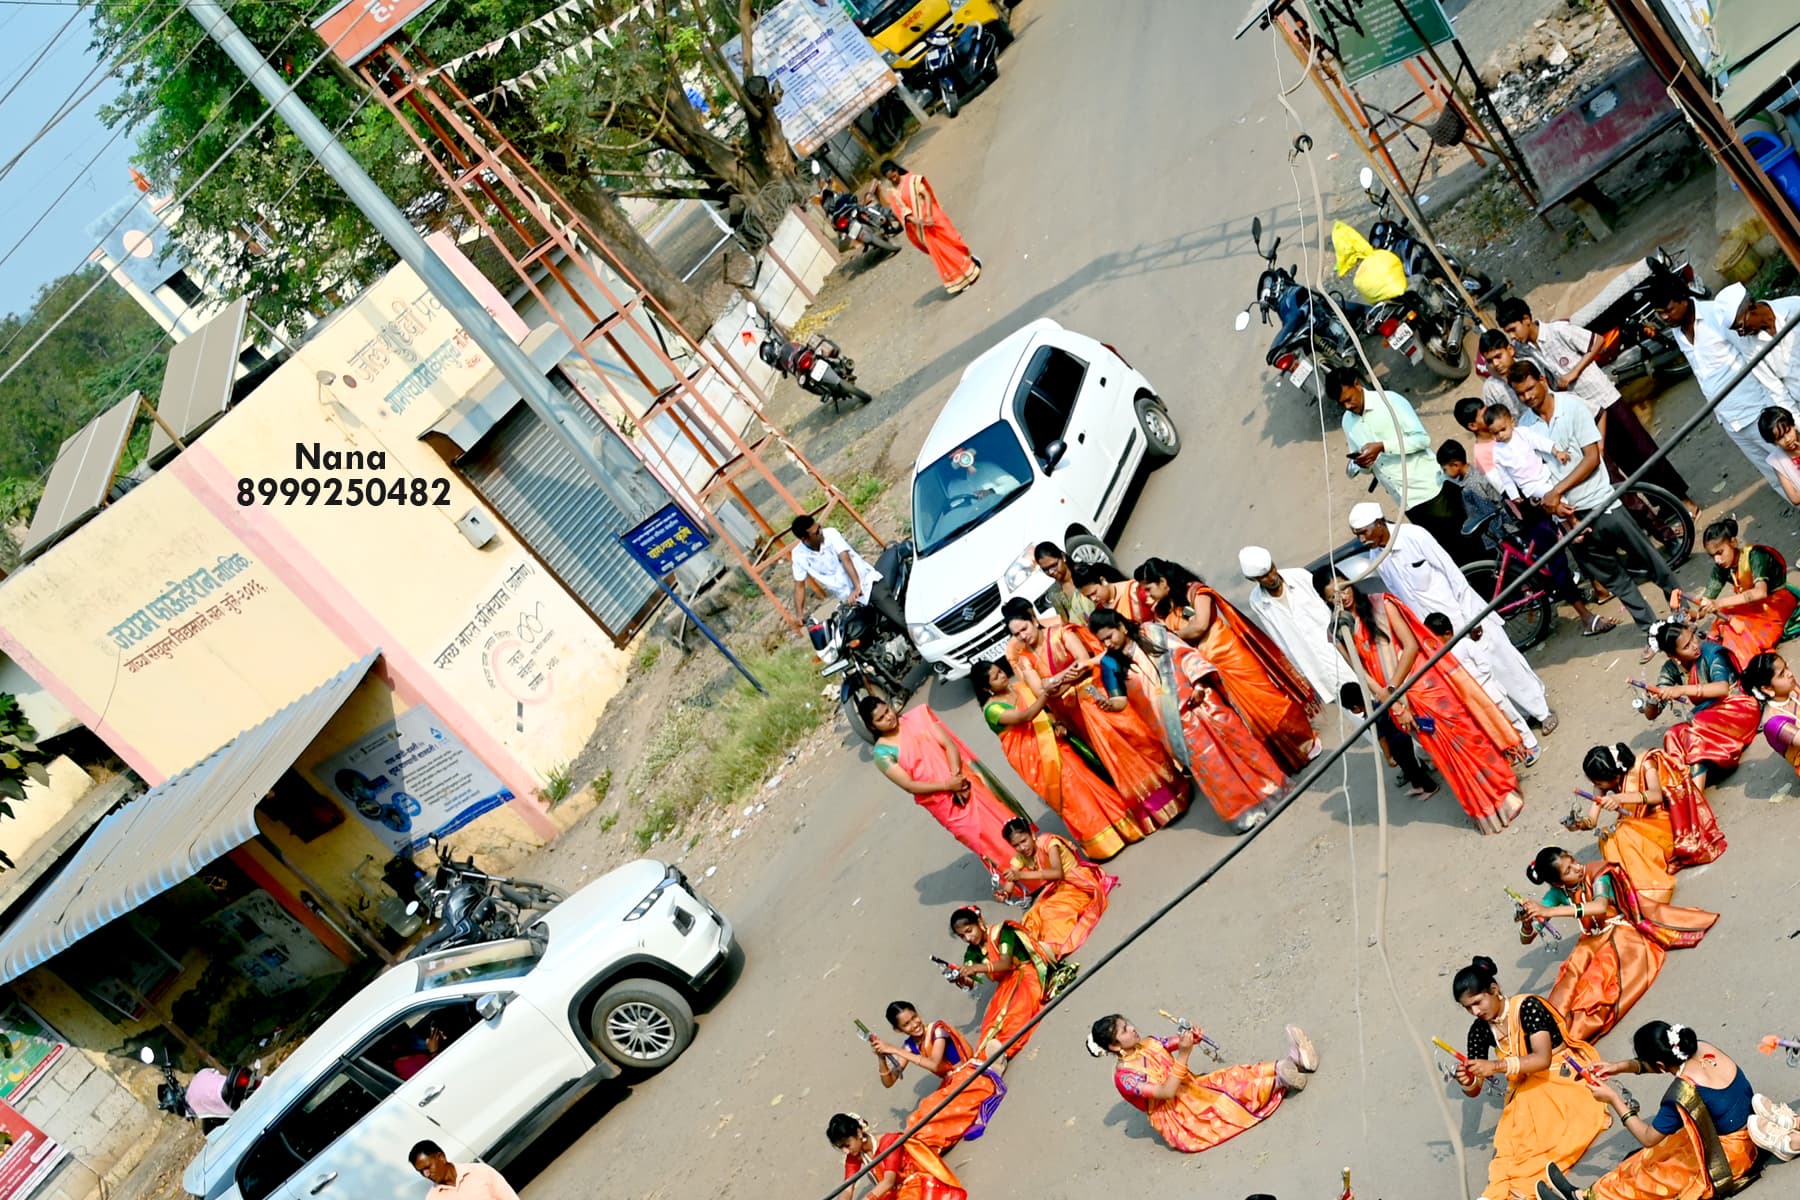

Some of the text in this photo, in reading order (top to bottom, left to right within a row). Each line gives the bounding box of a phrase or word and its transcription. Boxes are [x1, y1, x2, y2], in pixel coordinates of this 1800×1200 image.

[433, 643, 461, 669] स्वच्छ
[455, 622, 481, 647] भारत
[475, 588, 511, 627] अभियान
